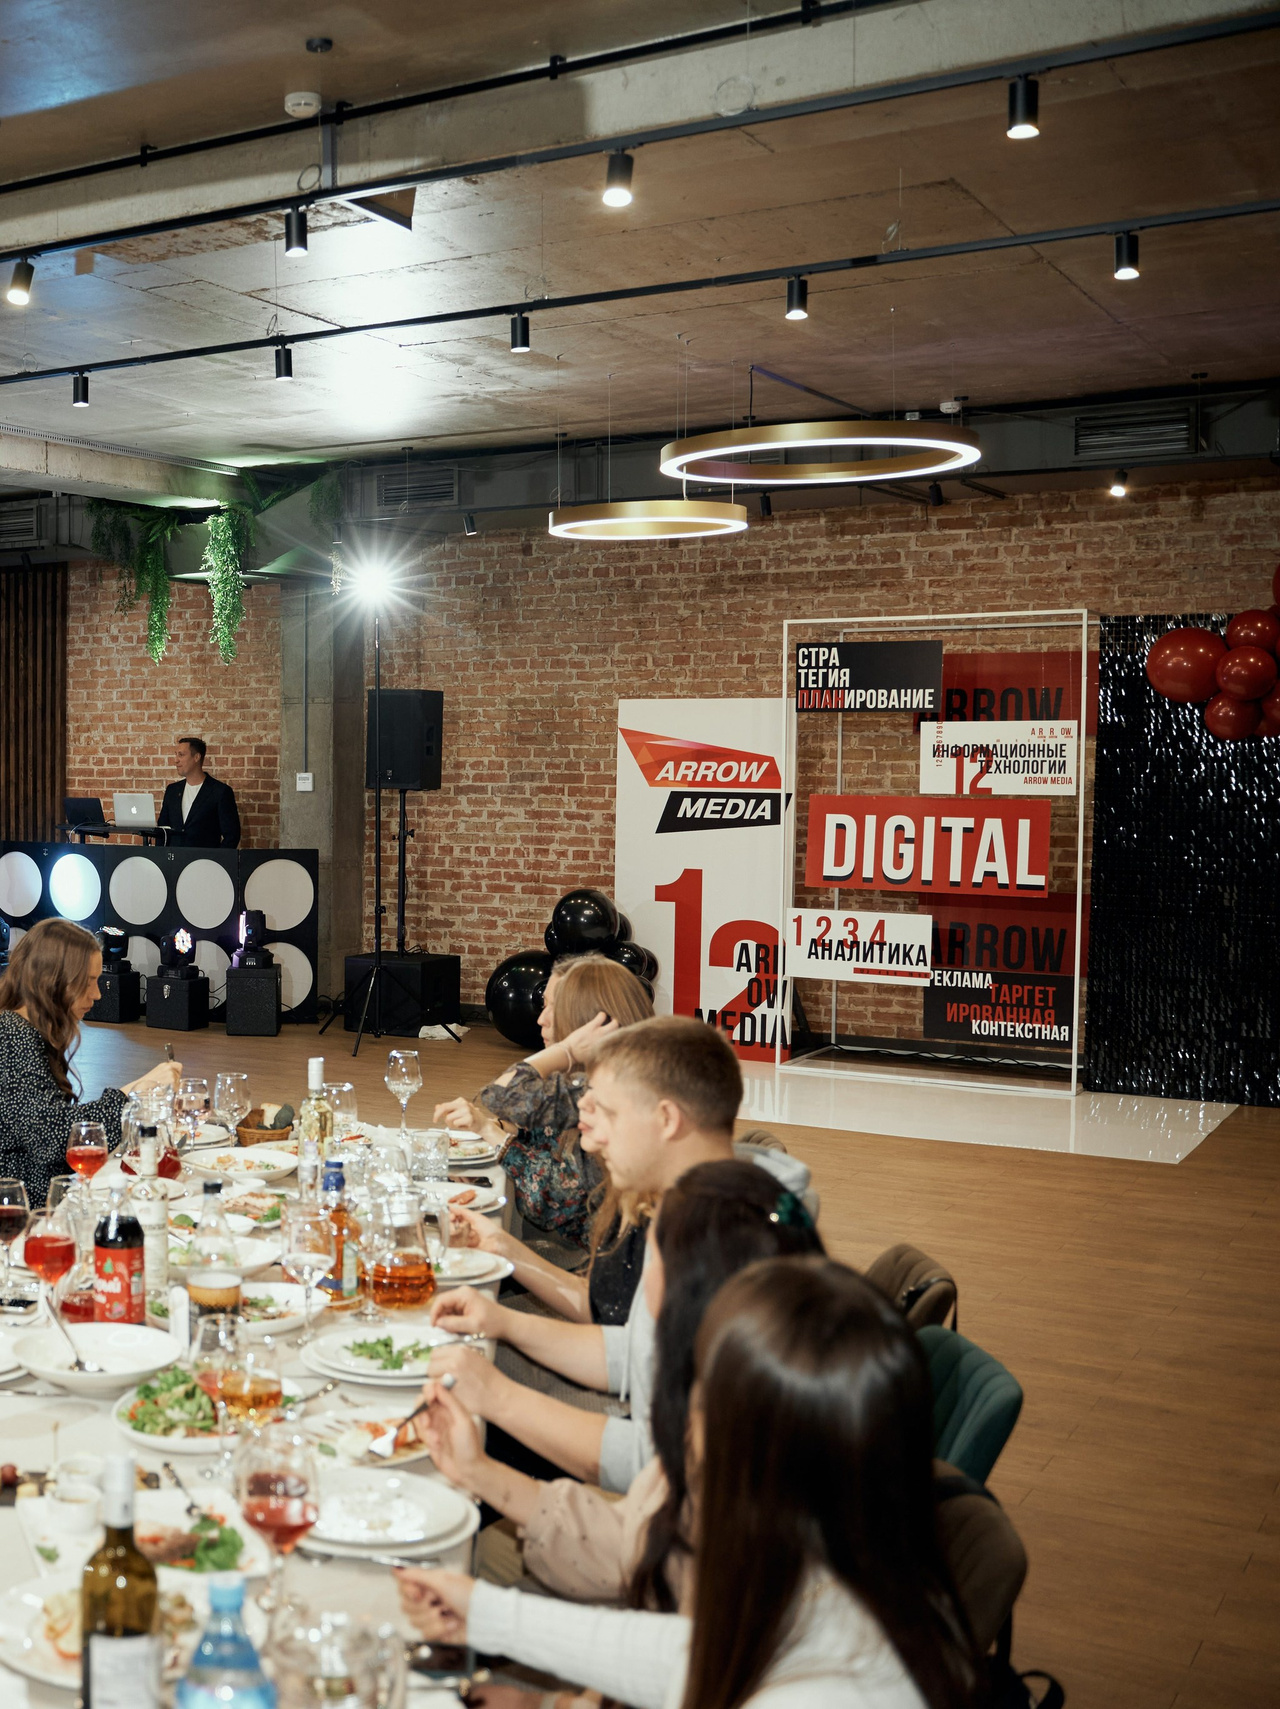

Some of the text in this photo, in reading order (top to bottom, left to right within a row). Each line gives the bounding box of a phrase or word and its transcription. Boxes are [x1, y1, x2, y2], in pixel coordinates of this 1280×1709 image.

[798, 647, 840, 667] СТРА
[798, 668, 850, 688] ТЕГИЯ
[798, 689, 935, 709] ПЛАНИРОВАНИЕ
[932, 743, 1067, 759] ИНФОРМАЦИОННЫЕ
[654, 761, 770, 783] ARROW
[978, 760, 1067, 774] ТЕХНОЛОГИИ
[1023, 776, 1073, 785] ARROW MEDIA
[676, 797, 772, 820] MEDIA
[822, 813, 1046, 889] DIGITAL
[807, 938, 928, 967] АНАЛИТИКА
[989, 983, 1056, 1007] ТАРГЕТ
[946, 1002, 1055, 1028] ИРОВАННАЯ
[971, 1019, 1070, 1041] КОНТЕКСТНАЯ
